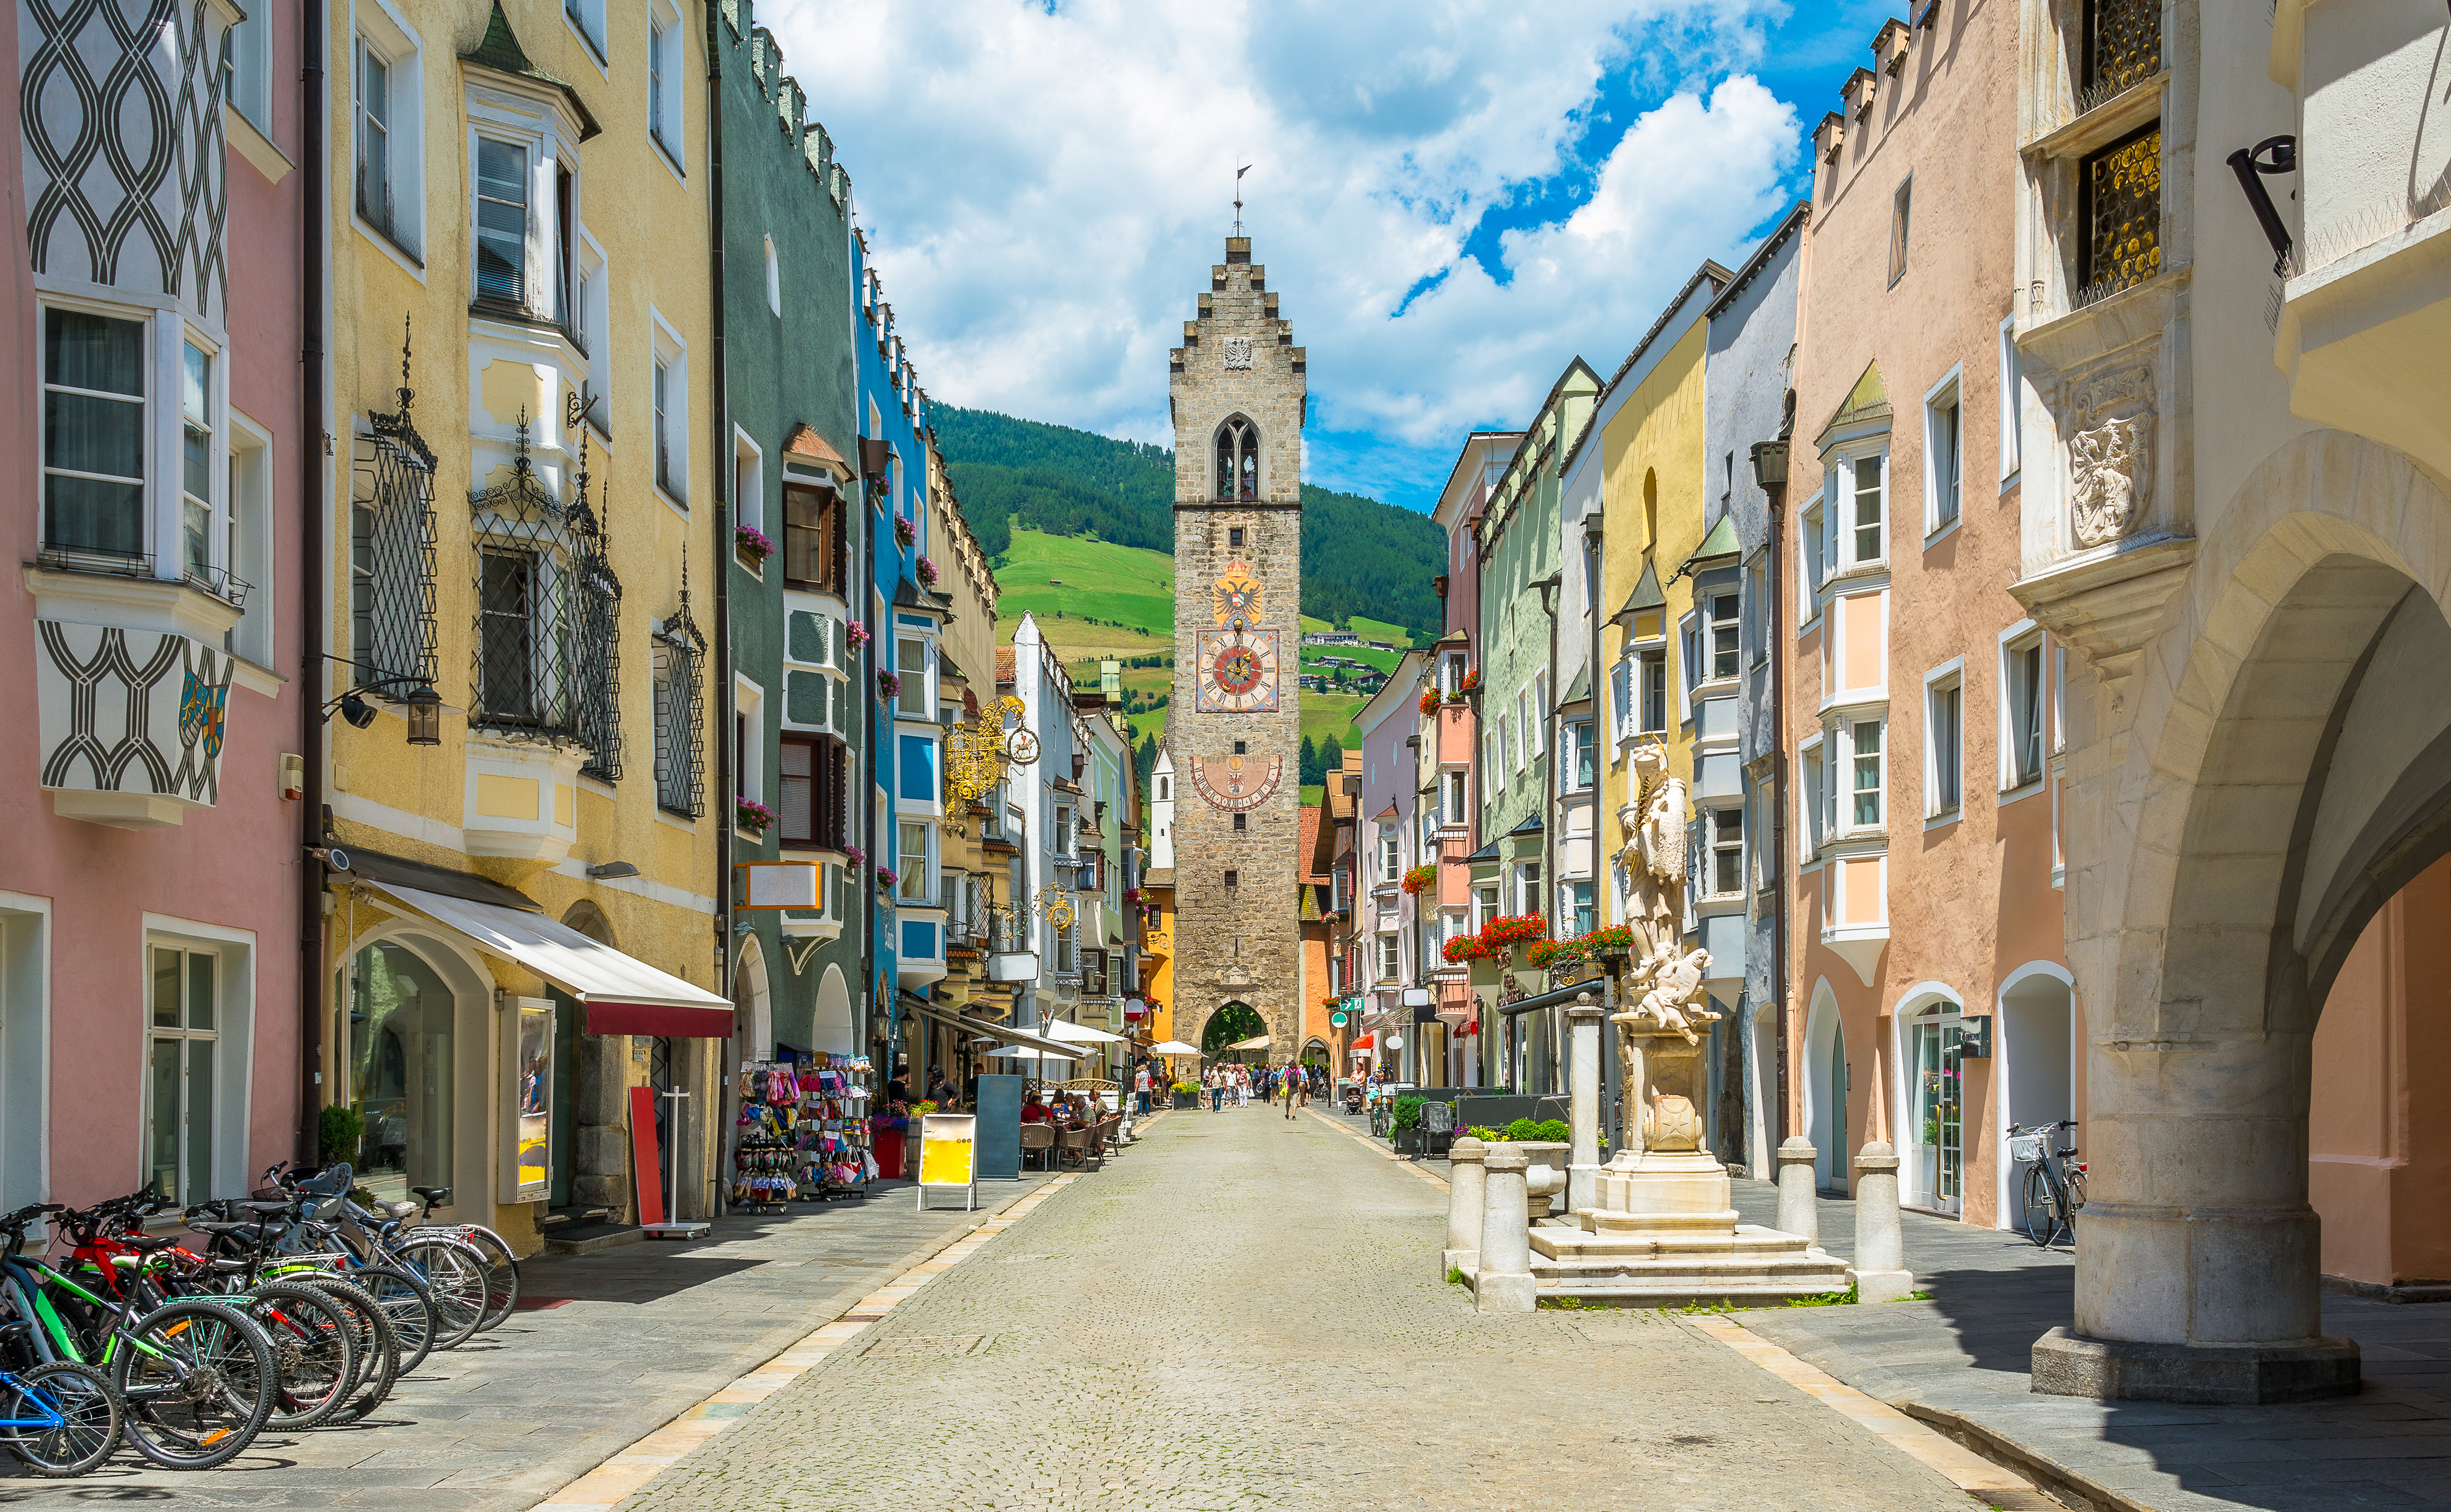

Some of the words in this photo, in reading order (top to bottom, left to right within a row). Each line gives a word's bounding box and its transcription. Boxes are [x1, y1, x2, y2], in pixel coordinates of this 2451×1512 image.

[1217, 637, 1227, 650] XI
[1250, 638, 1257, 648] I
[1206, 650, 1217, 659] X
[1260, 650, 1271, 659] II
[1251, 693, 1258, 703] V
[1209, 792, 1217, 801] IX
[1218, 796, 1224, 805] X
[1226, 798, 1231, 807] XI
[1248, 796, 1254, 804] II
[1257, 790, 1265, 798] III
